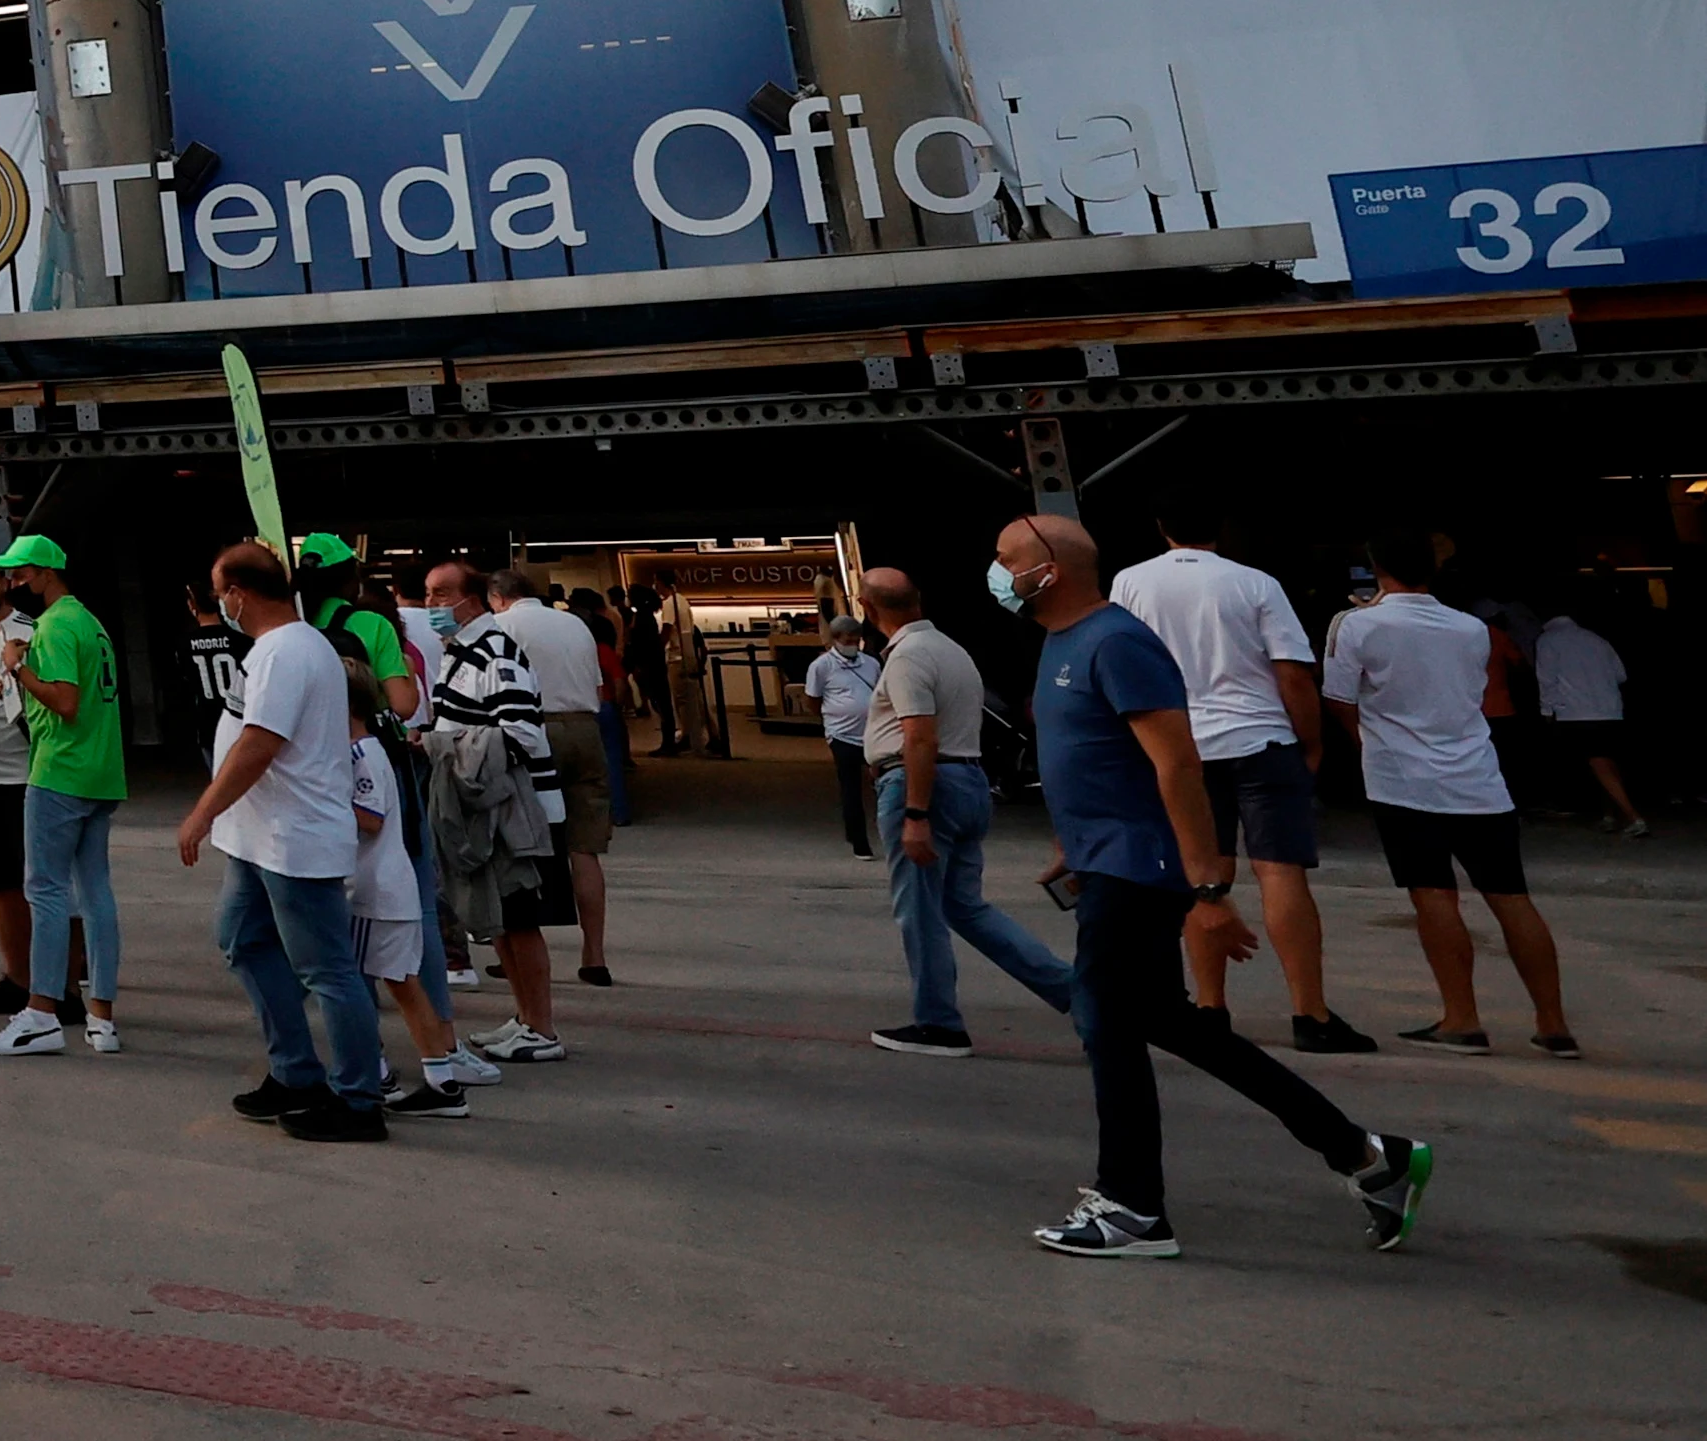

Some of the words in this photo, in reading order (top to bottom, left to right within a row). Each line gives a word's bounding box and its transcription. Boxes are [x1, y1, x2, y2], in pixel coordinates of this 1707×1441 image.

[60, 133, 587, 277] Tienda
[633, 63, 1219, 237] Oficial
[1351, 184, 1427, 203] Puerta
[1448, 182, 1626, 274] 32
[191, 652, 238, 700] 10
